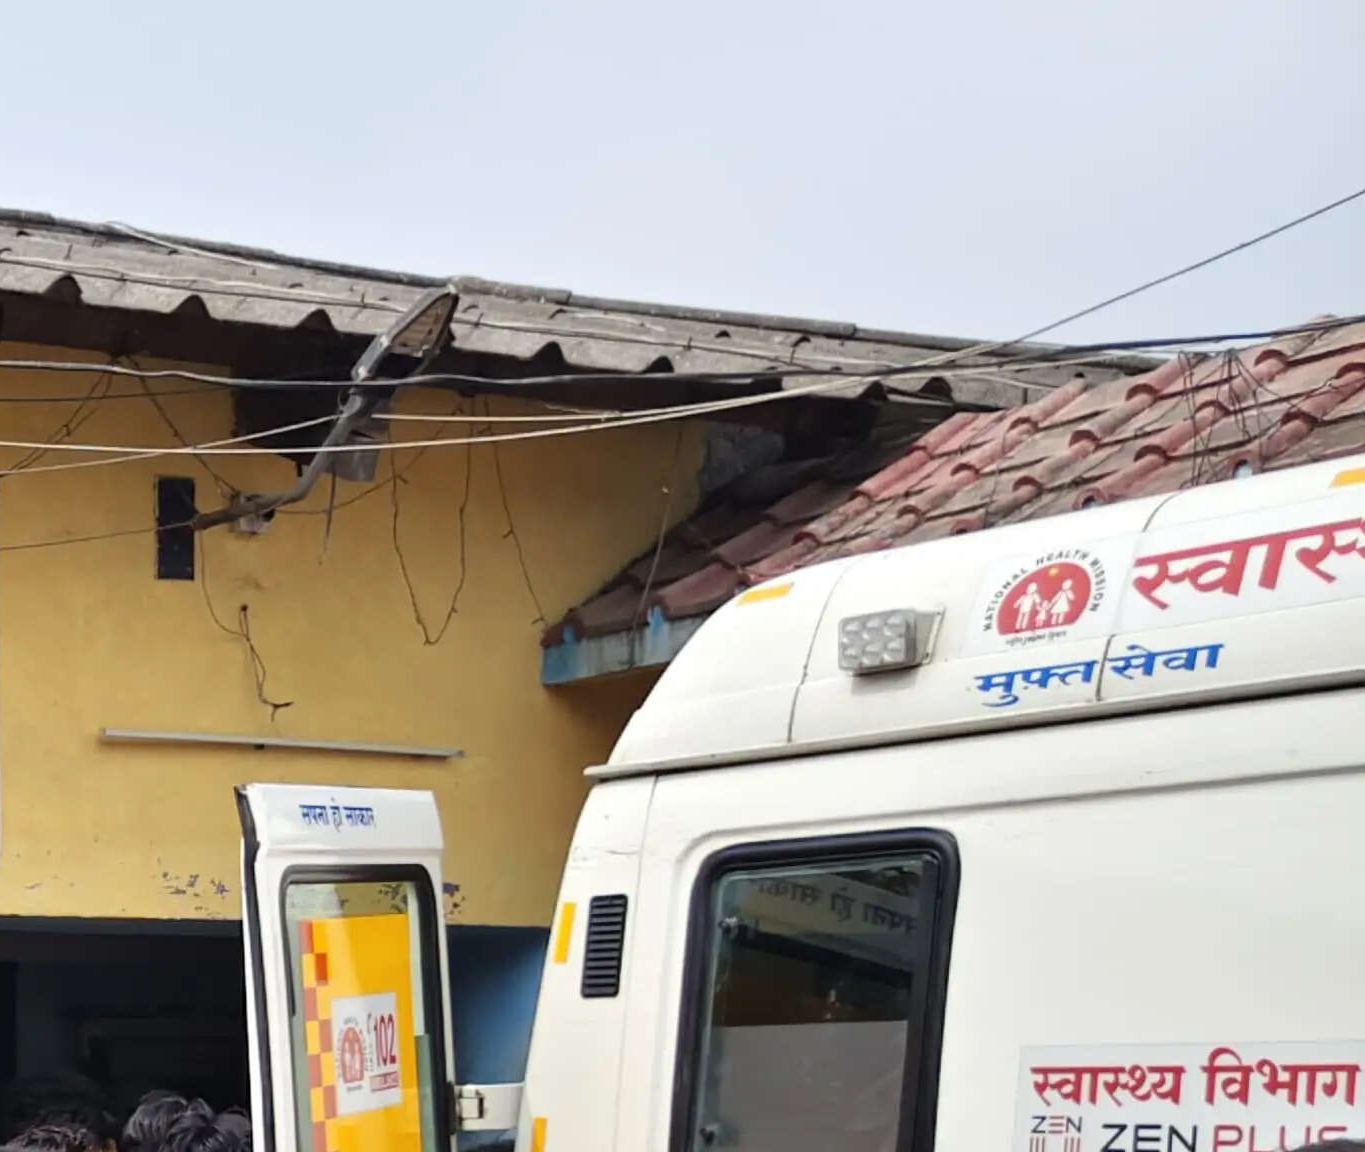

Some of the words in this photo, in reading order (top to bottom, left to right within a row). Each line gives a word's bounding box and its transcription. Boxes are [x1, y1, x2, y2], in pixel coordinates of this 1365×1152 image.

[983, 568, 1028, 632] NATIONAL
[1036, 549, 1090, 566] HEALTH
[1089, 557, 1107, 612] MISSION
[1133, 516, 1365, 611] स्वास्
[1107, 643, 1224, 680] सेवा
[374, 1013, 397, 1067] 102
[1030, 1064, 1186, 1107] स्वास्थ्य
[1200, 1047, 1361, 1107] विभाग
